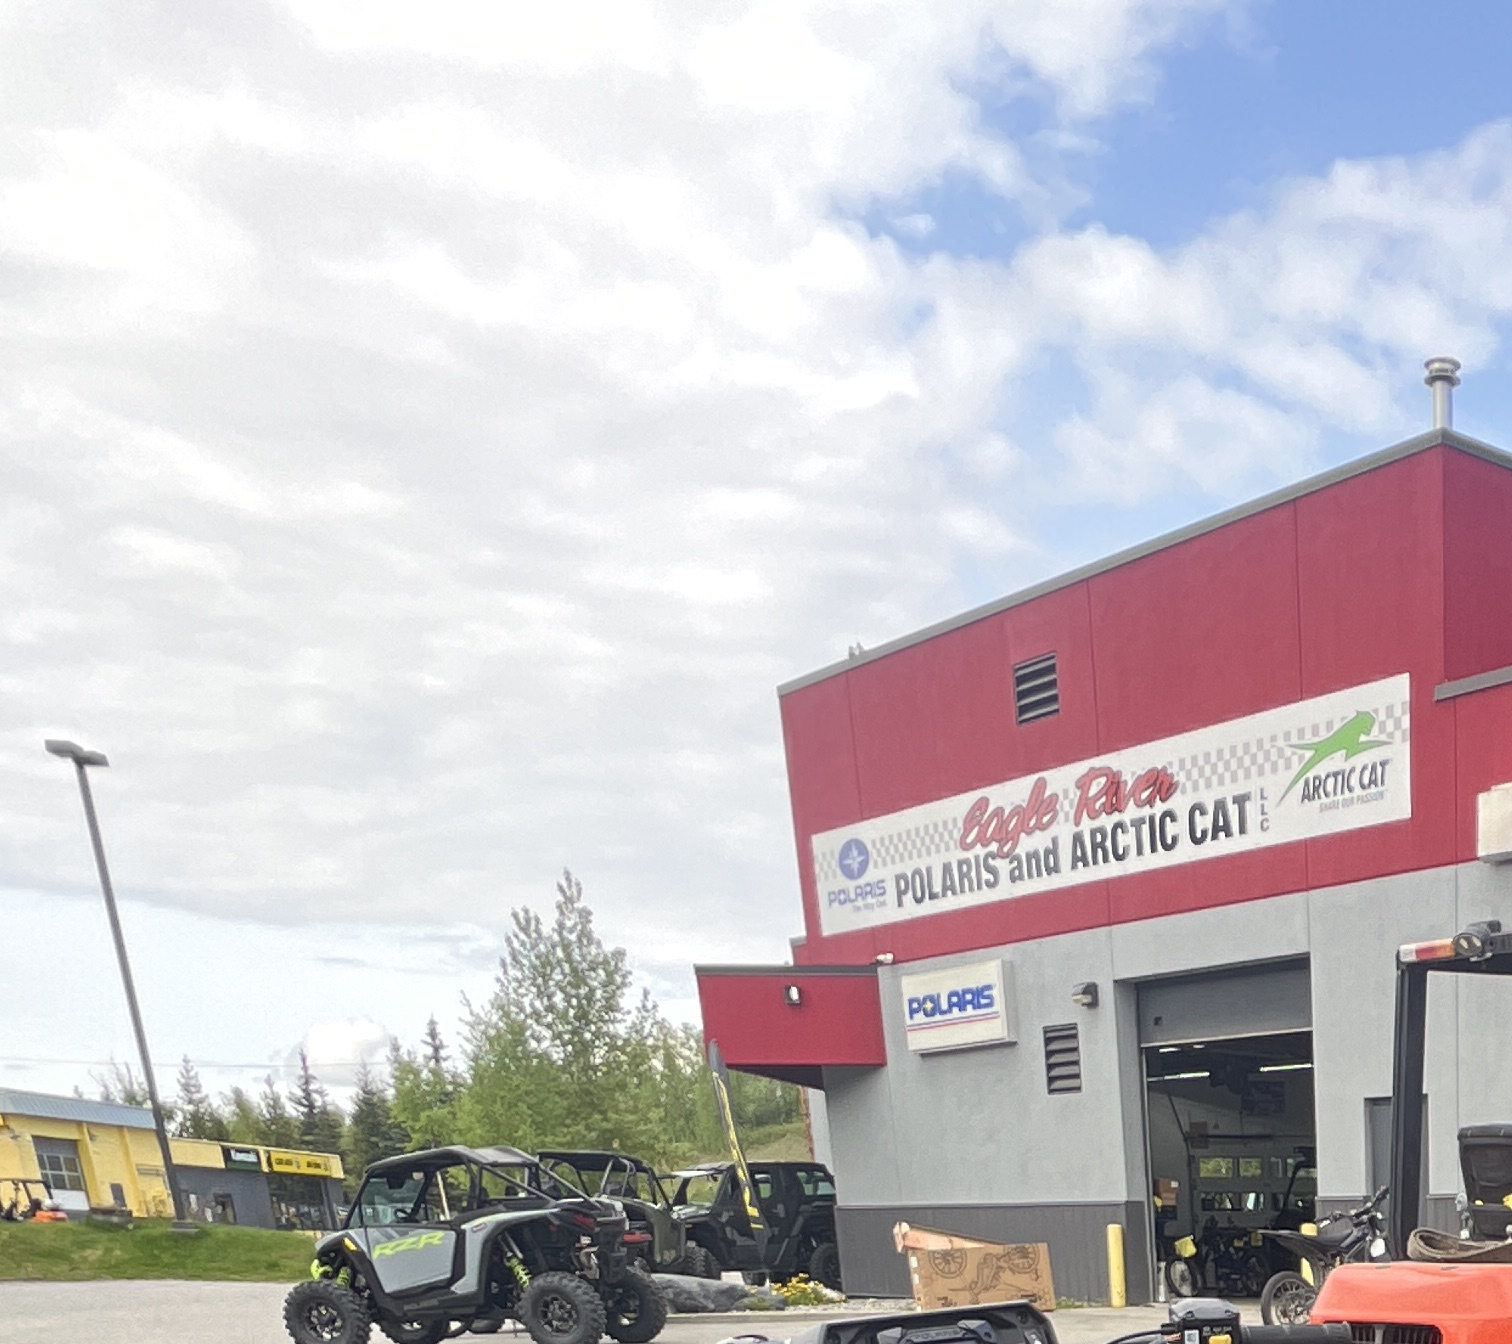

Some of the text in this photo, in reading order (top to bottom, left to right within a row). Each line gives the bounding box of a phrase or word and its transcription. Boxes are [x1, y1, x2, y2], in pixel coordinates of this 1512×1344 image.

[1301, 758, 1390, 804] ARCTIC CAT
[960, 767, 1180, 858] Eagle River
[894, 790, 1253, 908] POLARIS and ARCTIC CAT
[828, 879, 887, 908] POLARIS
[907, 984, 995, 1021] POLARIS
[373, 1231, 446, 1260] RZR
